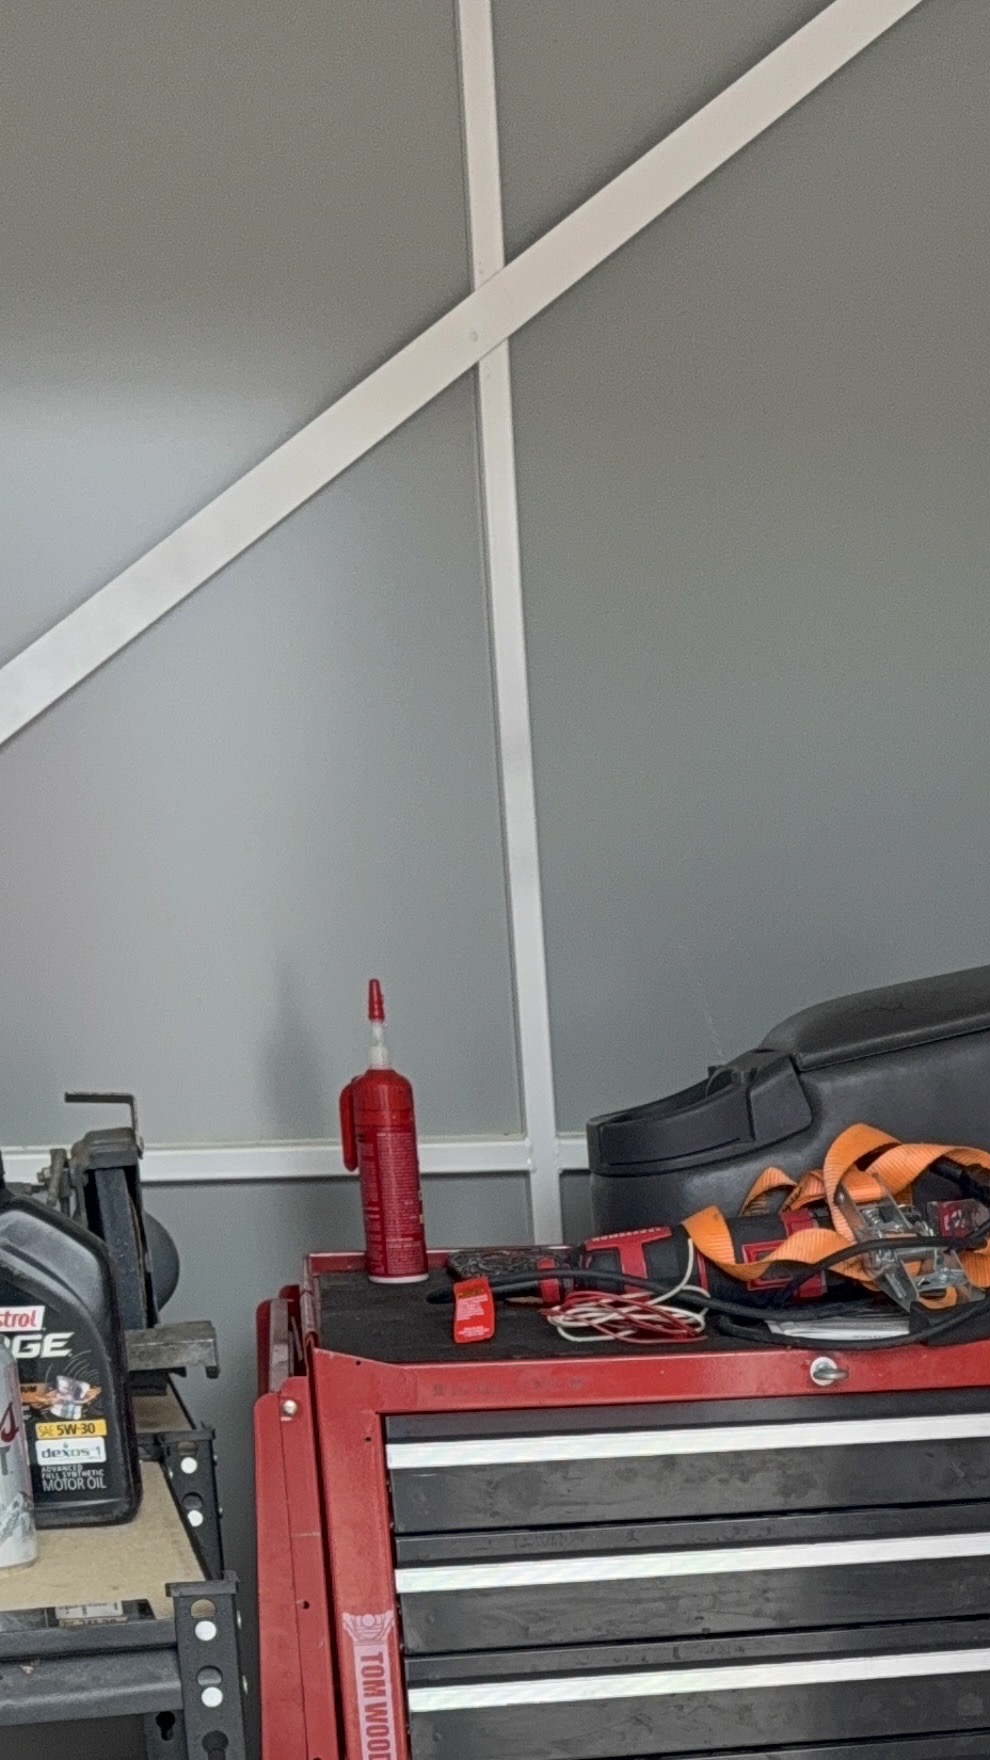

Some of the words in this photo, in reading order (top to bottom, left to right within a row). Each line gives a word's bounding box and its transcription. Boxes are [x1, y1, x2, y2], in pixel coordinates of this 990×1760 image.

[0, 1309, 37, 1328] trol
[56, 1422, 96, 1436] 5W-30
[43, 1478, 85, 1492] MOTOR
[86, 1476, 107, 1490] OIL
[360, 1651, 386, 1698] TOM
